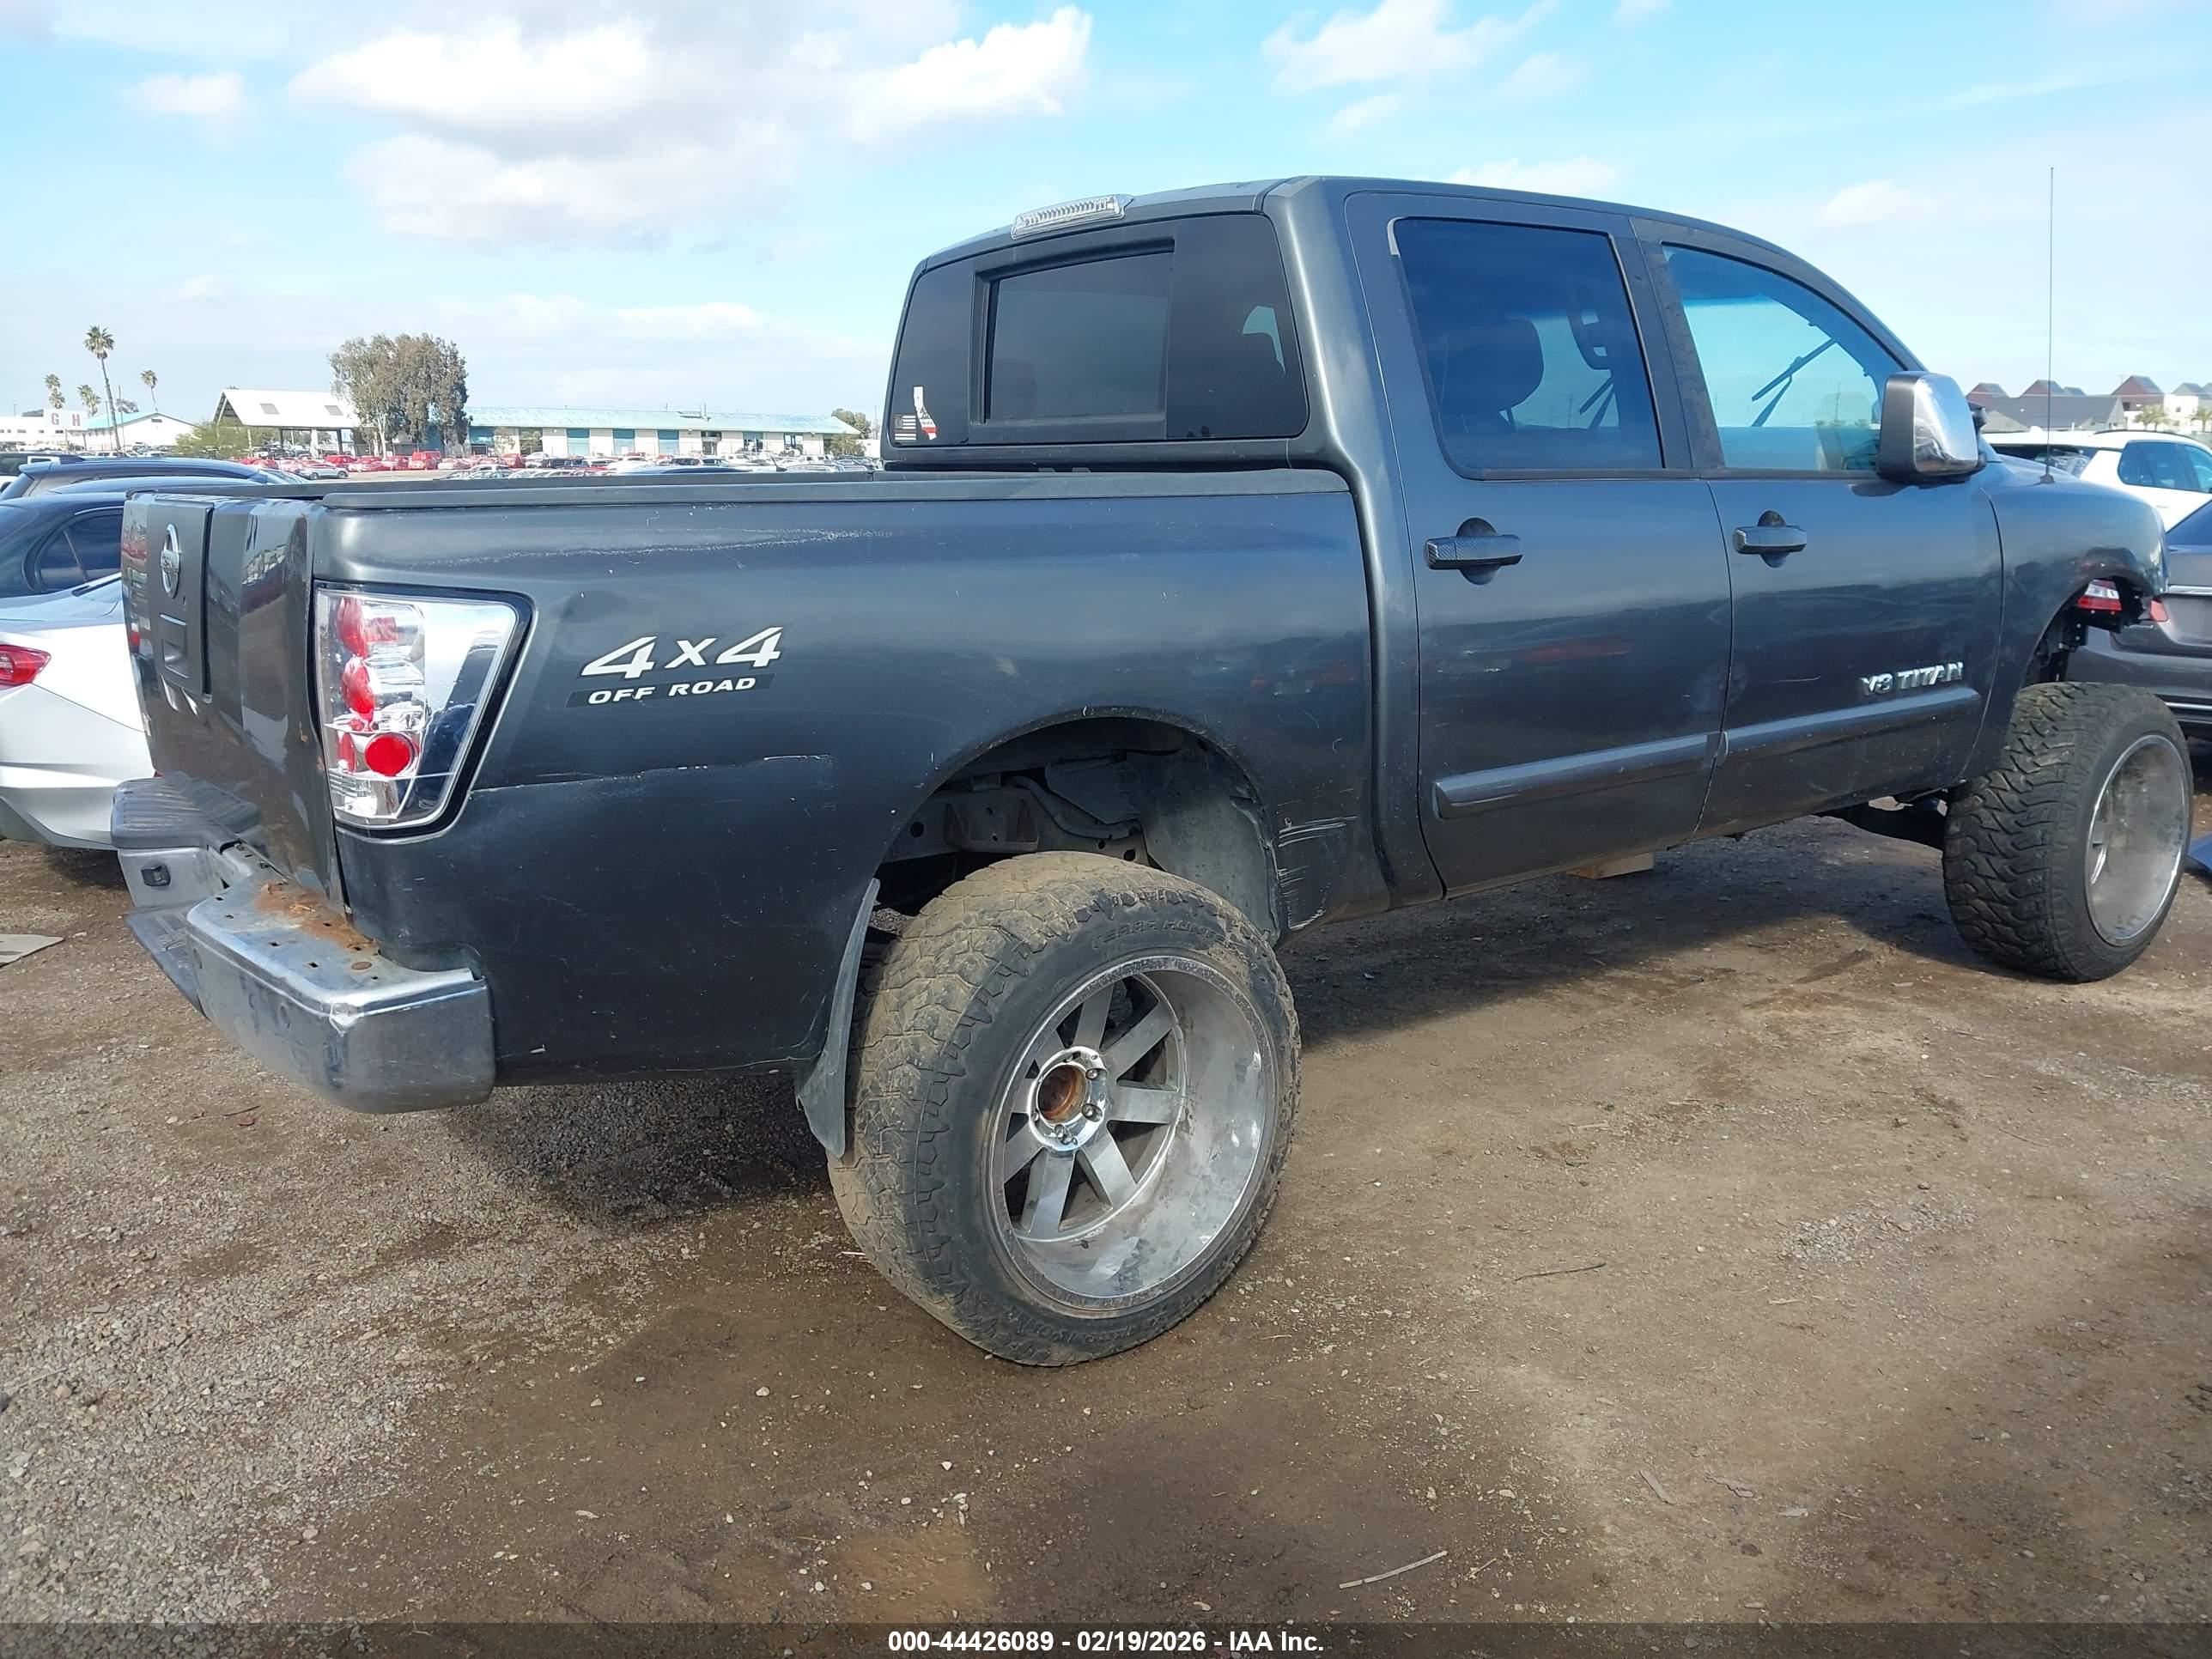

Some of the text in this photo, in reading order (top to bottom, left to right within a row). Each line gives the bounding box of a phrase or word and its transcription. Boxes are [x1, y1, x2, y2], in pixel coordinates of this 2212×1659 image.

[51, 412, 59, 426] G
[72, 413, 81, 427] H
[1896, 660, 1965, 690] TITAN
[587, 677, 757, 705] OFF ROAD
